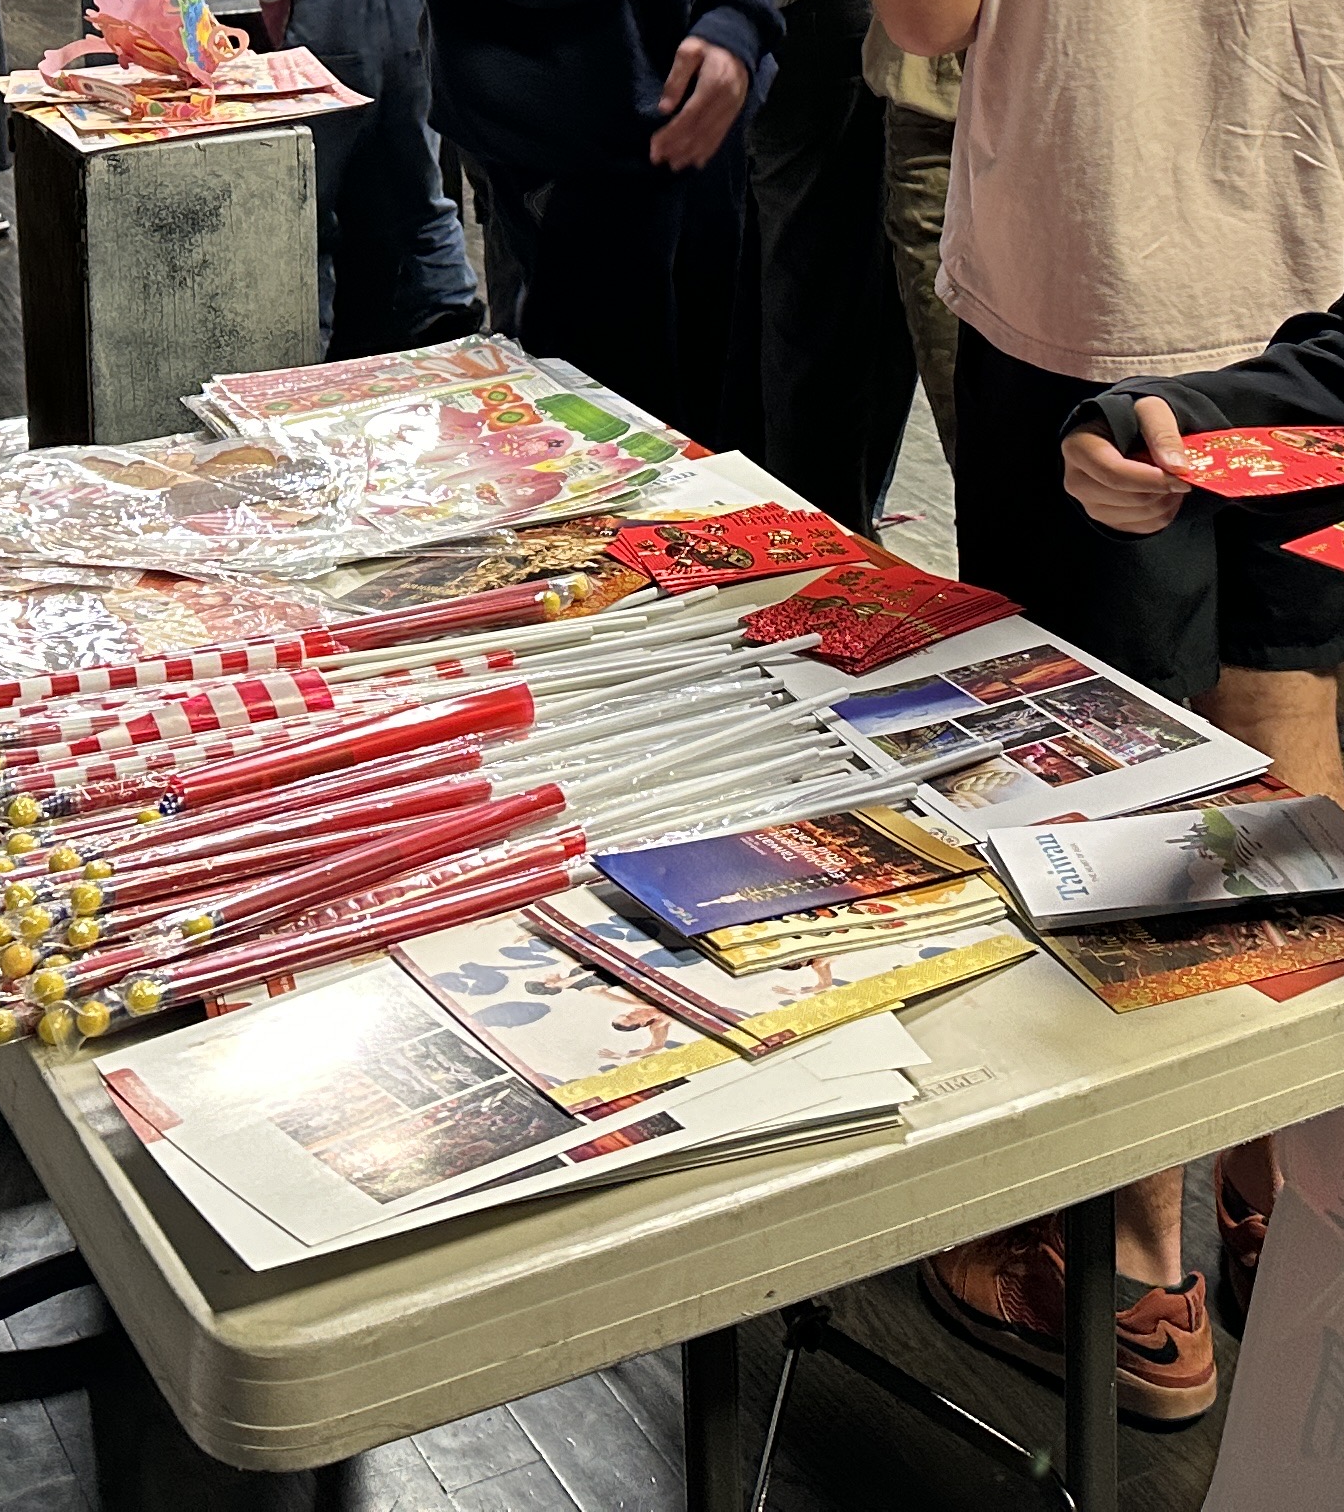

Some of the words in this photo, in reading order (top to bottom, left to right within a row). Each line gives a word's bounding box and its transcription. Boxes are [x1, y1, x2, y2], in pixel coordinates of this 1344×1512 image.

[755, 832, 794, 862] Taiwan
[781, 826, 819, 848] Card
[772, 830, 845, 879] Employment
[814, 844, 847, 866] Gold
[1035, 833, 1090, 901] Taiwan
